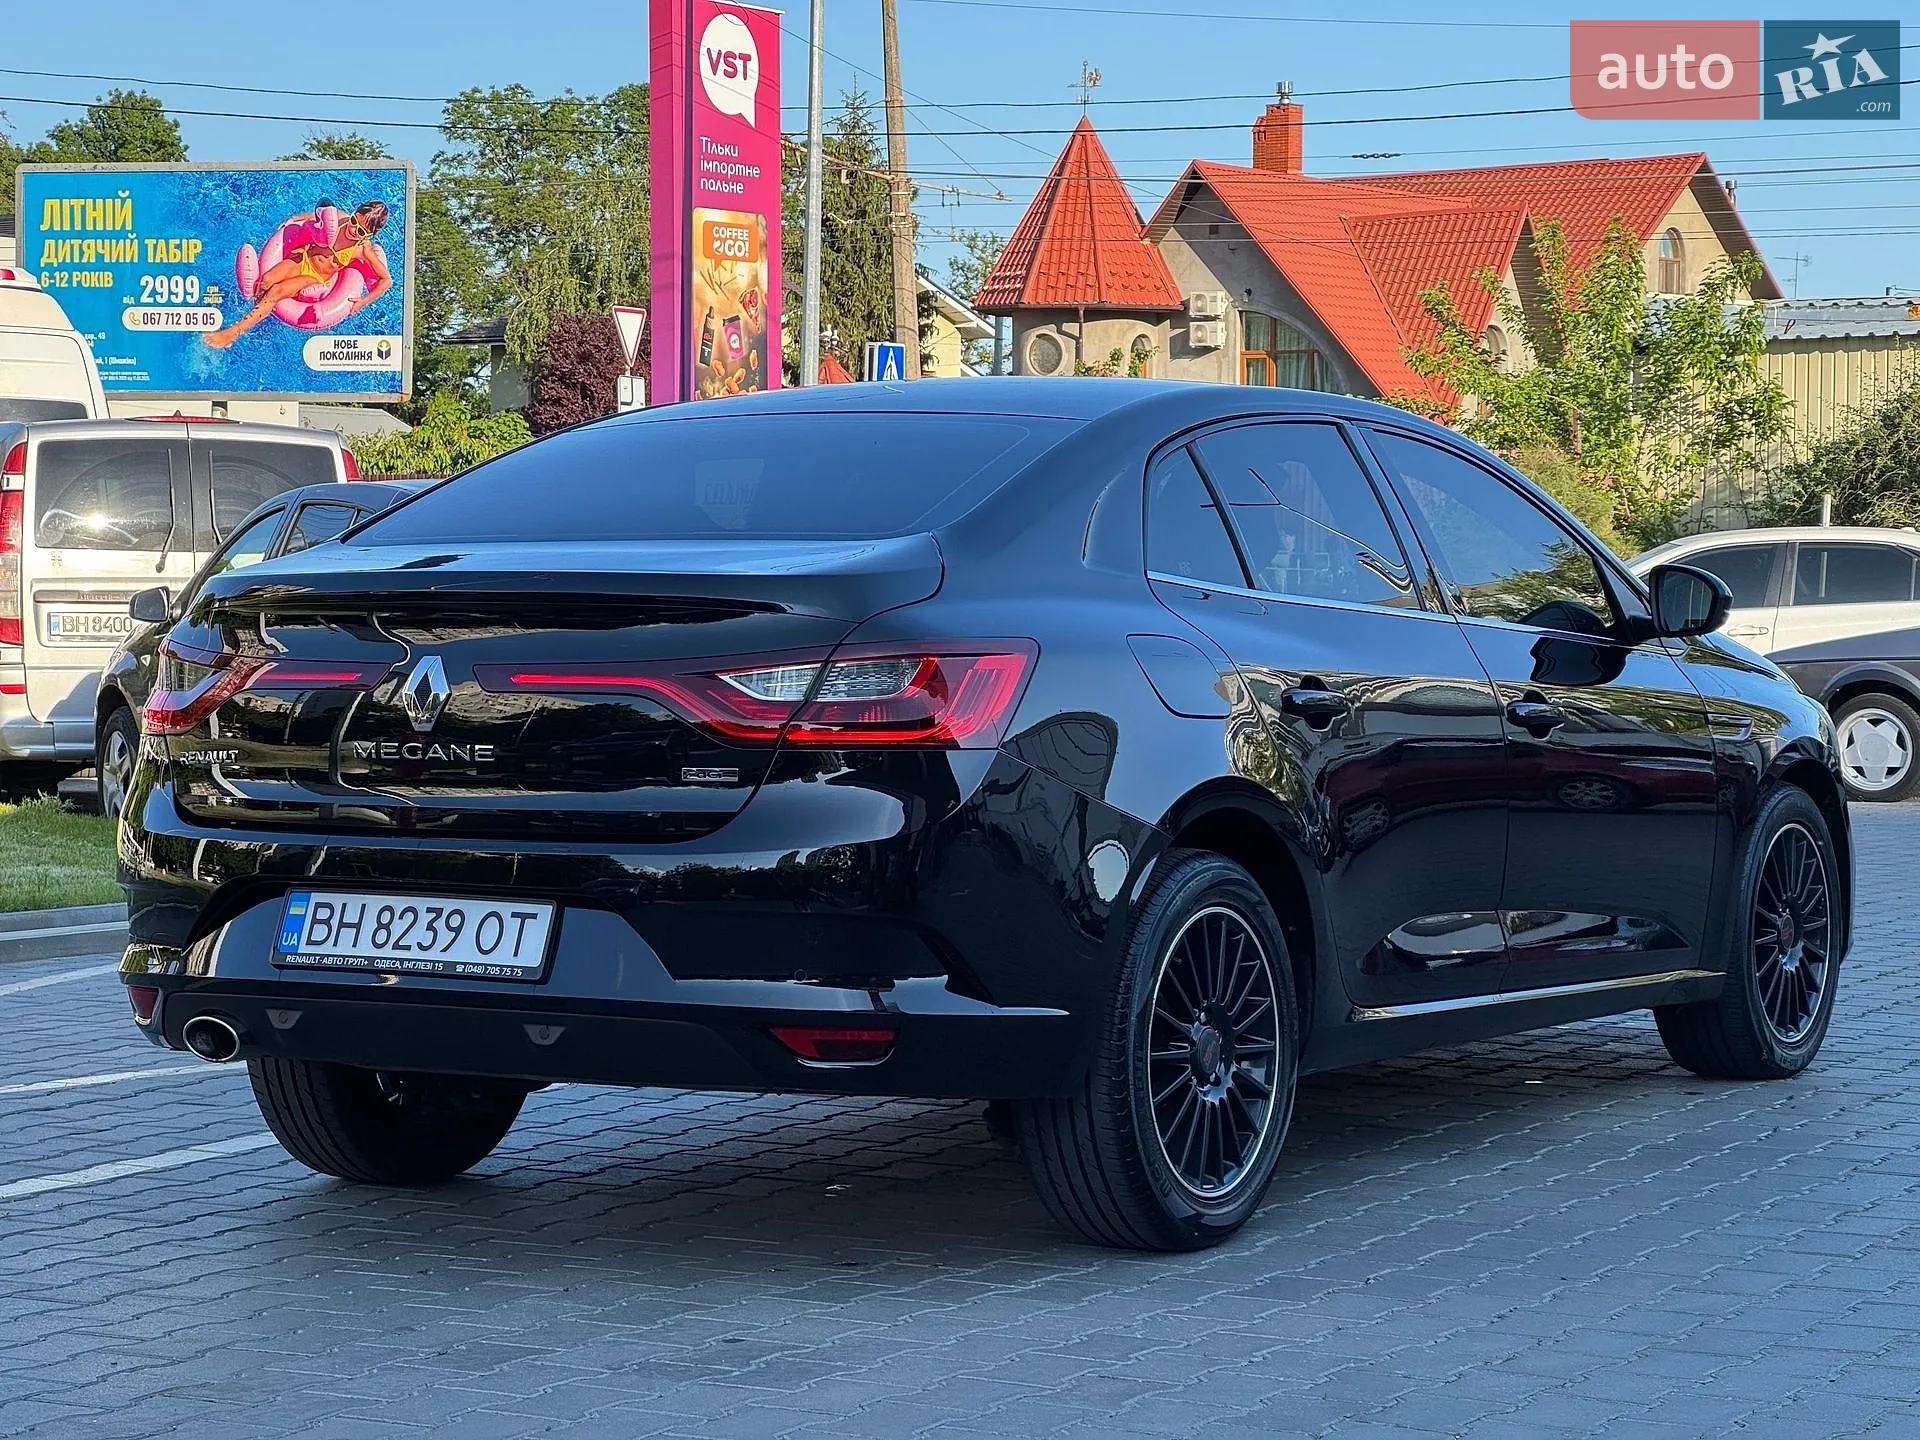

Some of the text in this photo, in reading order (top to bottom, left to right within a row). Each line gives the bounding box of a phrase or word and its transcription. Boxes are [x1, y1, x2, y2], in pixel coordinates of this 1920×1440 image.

[707, 48, 752, 80] VST
[700, 136, 739, 157] Тільки
[700, 155, 760, 179] імпортне
[701, 178, 744, 194] пальне
[40, 190, 132, 231] ЛІТНІЙ
[713, 226, 749, 240] COFFEE
[40, 233, 202, 267] ДИТЯЧИЙ ТАБІР
[41, 272, 113, 287] 6-12 РОКІВ
[140, 275, 200, 304] 2999
[142, 312, 215, 326] 067 712 05 05
[333, 340, 359, 349] НОВЕ
[319, 351, 373, 361] ПОКОЛІННЯ
[62, 616, 88, 632] BH
[92, 616, 132, 633] 8400
[180, 750, 238, 764] RENAULT
[353, 742, 495, 762] MEGANE
[305, 902, 538, 957] BH 8239 OT
[282, 932, 298, 946] UA
[374, 959, 401, 969] ОДЕСА,
[434, 963, 443, 971] 15
[465, 964, 485, 974] (048)
[486, 966, 500, 975] 705
[501, 967, 511, 976] 75
[512, 968, 523, 977] 75
